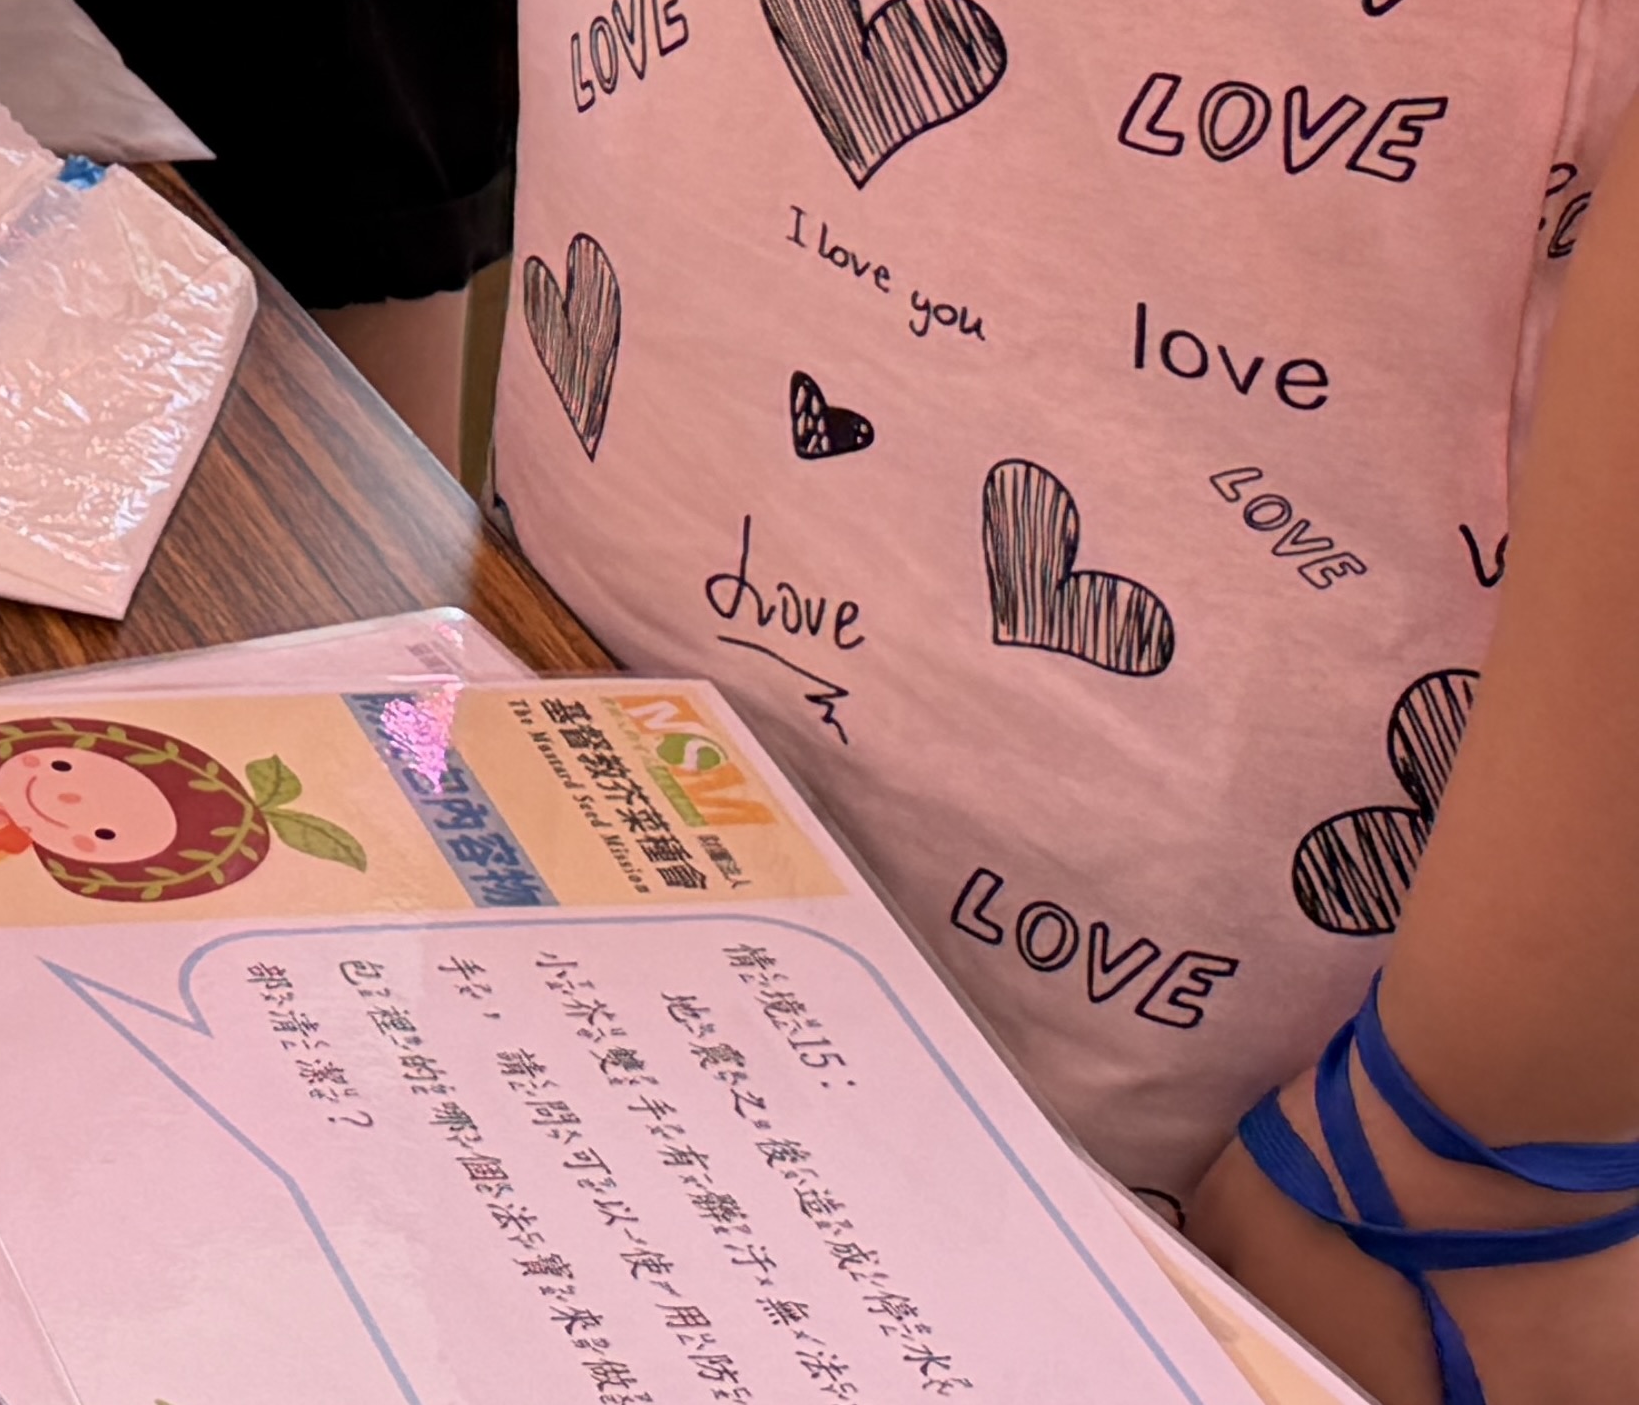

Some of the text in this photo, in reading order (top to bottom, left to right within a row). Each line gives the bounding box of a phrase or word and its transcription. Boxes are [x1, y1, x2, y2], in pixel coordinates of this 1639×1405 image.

[1117, 71, 1449, 184] LOVE
[786, 204, 987, 343] I love you
[1132, 301, 1330, 411] love
[1208, 464, 1368, 590] LOVE
[507, 698, 651, 895] The Mustard Seed Mission
[539, 697, 710, 891] 基督教芥菜種會
[615, 693, 779, 826] NSM
[949, 866, 1239, 1029] LOVE
